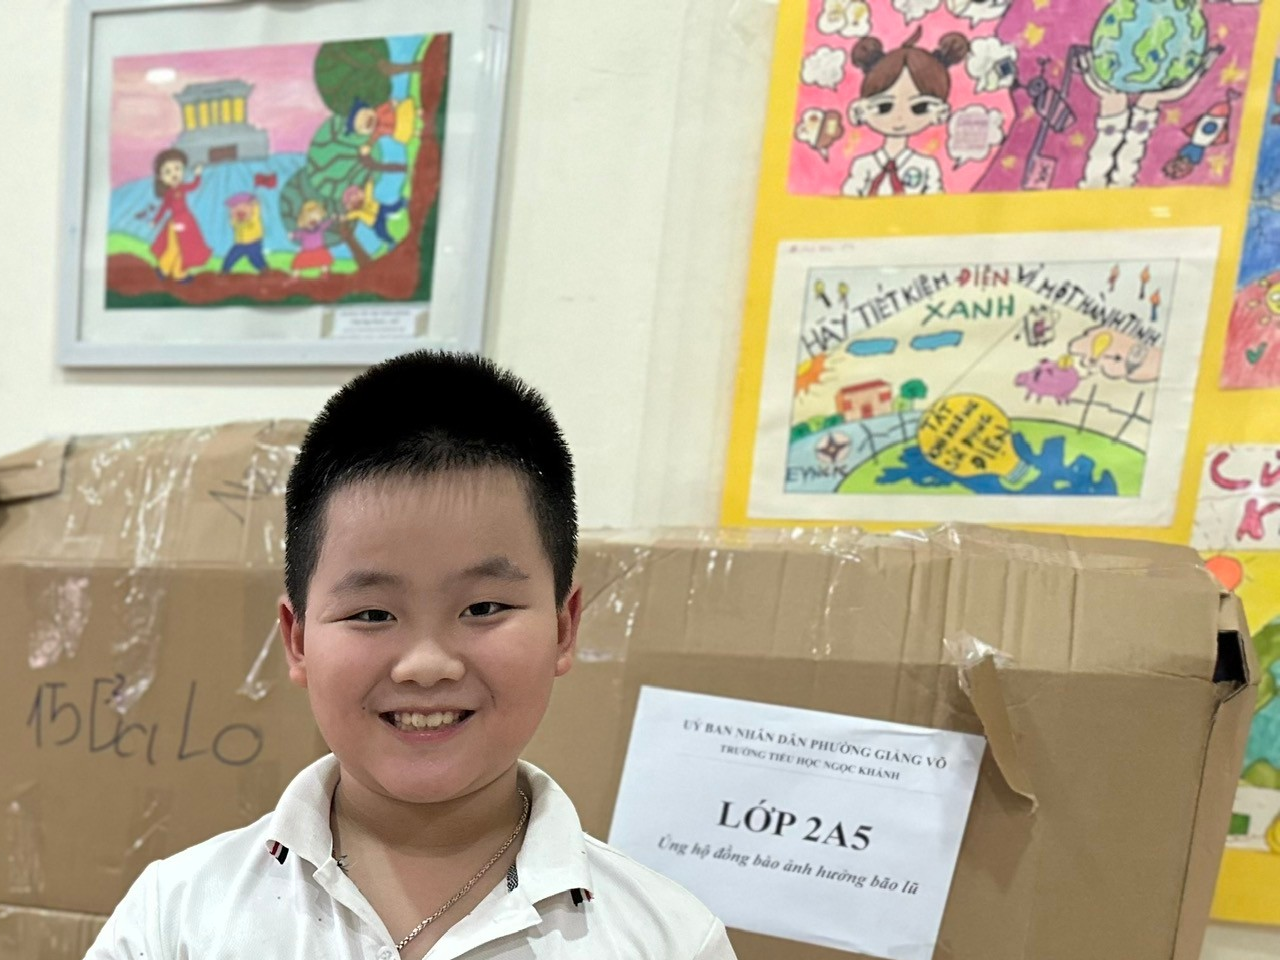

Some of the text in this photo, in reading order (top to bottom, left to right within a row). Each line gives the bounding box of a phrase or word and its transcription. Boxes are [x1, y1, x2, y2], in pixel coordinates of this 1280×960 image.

[956, 265, 1010, 292] ĐIỆN
[920, 295, 1015, 326] XANH
[27, 682, 81, 747] 15
[177, 680, 263, 766] Lo
[704, 722, 948, 770] BAN NHÂN DÂN PHƯỜNG GIẢNG VÕ
[721, 744, 900, 781] TRƯỜNG TIỂU HỌC NGỌC KHÁNH
[717, 798, 873, 851] LỚP 2A5
[690, 842, 711, 860] hộ
[713, 844, 751, 868] đồng
[753, 853, 781, 871] bào
[783, 859, 813, 877] ảnh
[816, 866, 868, 889] hưởng
[870, 874, 899, 892] bão
[901, 880, 920, 896] lũ
